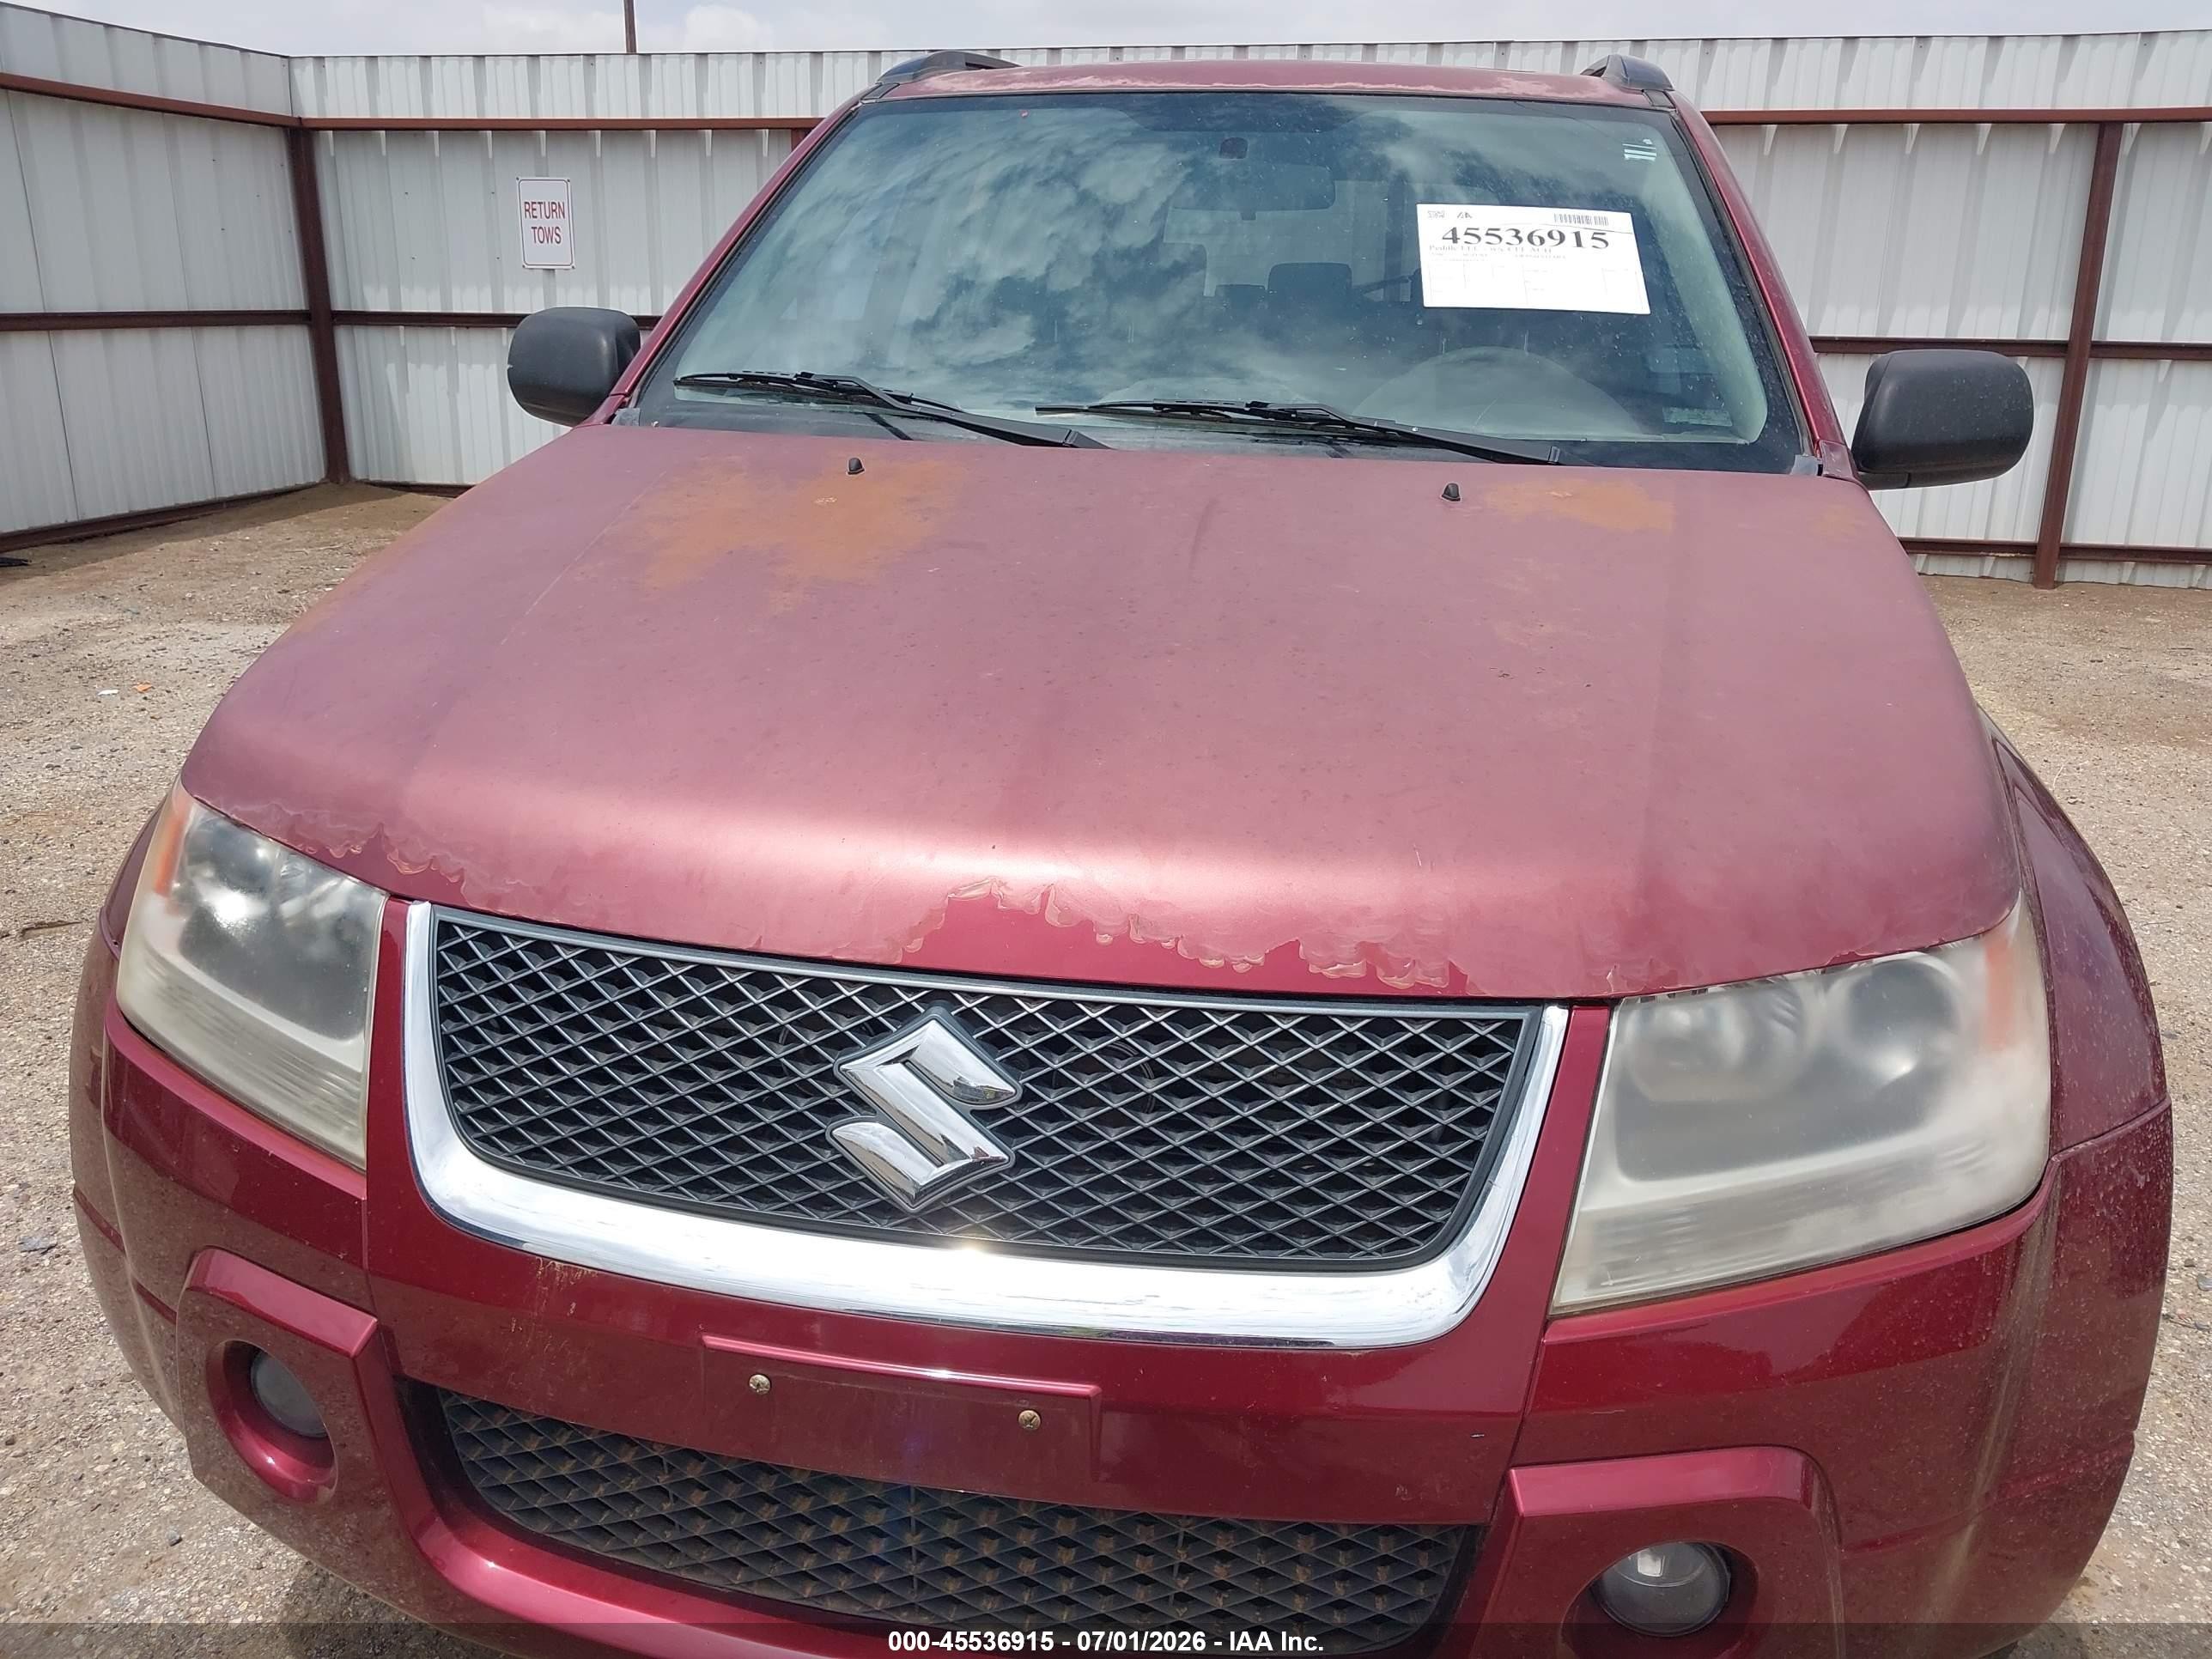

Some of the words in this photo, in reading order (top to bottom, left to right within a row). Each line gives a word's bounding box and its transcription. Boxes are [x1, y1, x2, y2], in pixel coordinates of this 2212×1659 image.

[524, 201, 565, 219] RETURN
[531, 226, 562, 244] TOWS
[1442, 227, 1609, 249] 45536915
